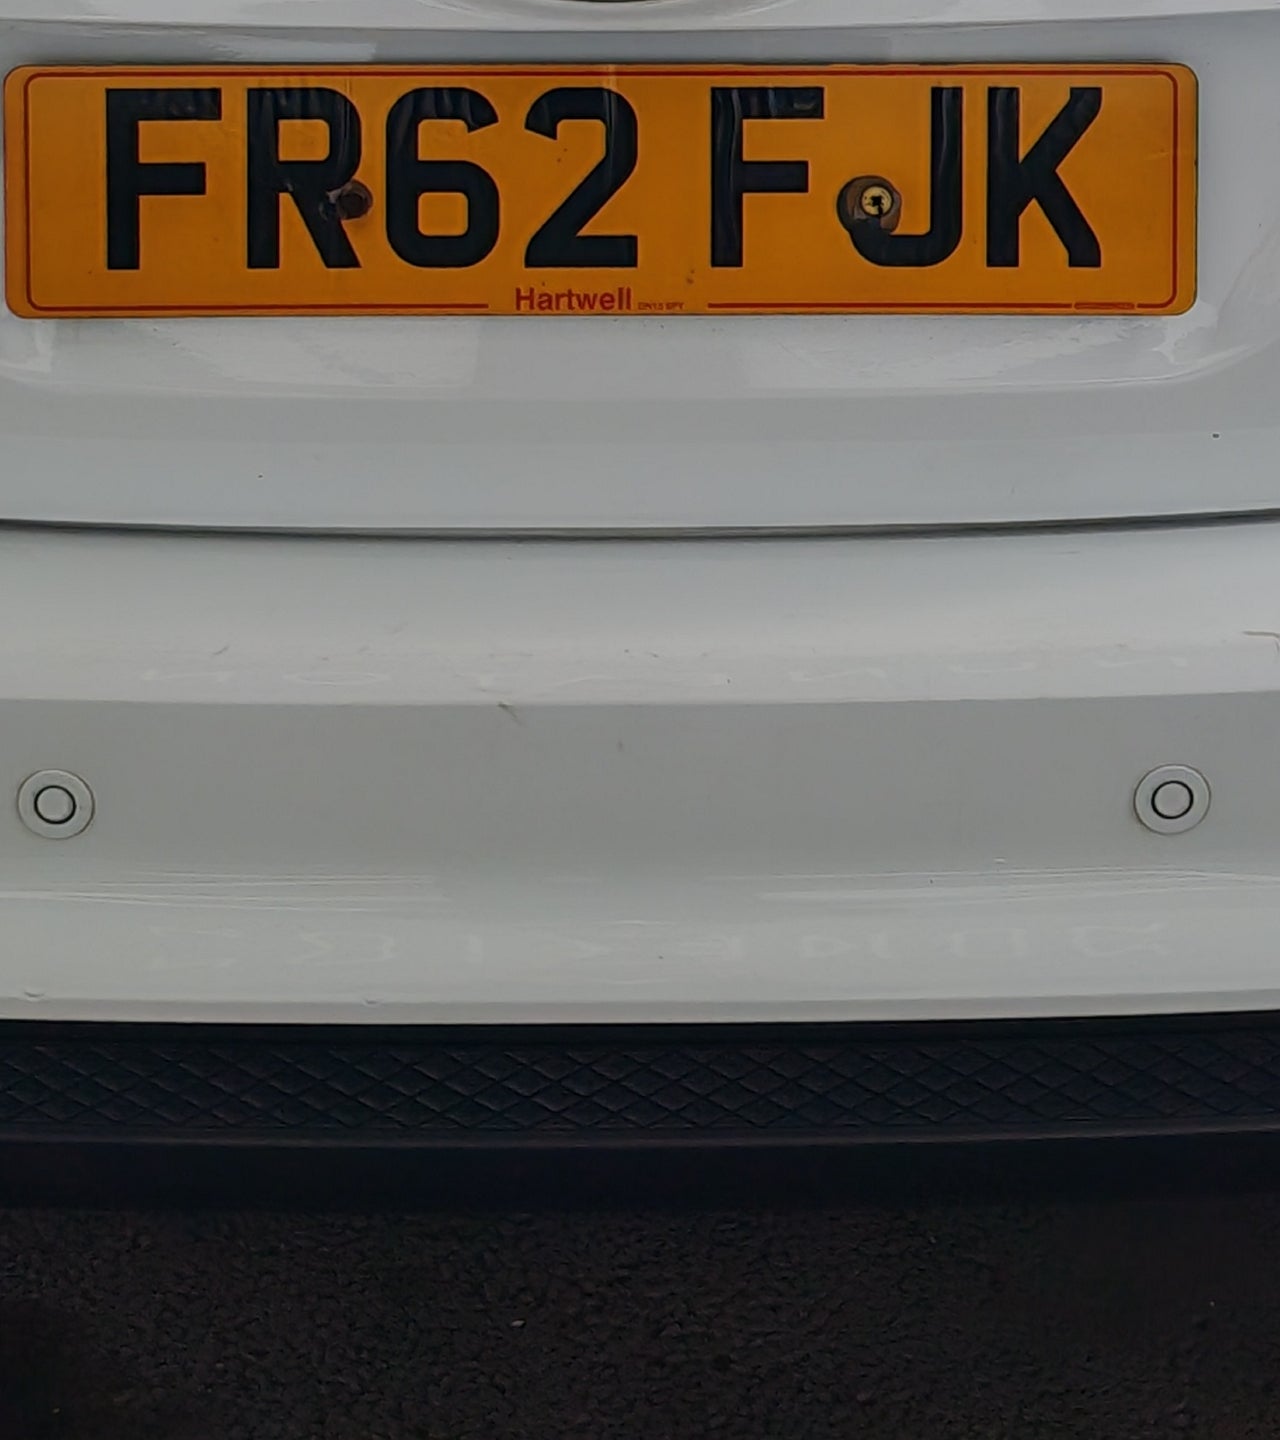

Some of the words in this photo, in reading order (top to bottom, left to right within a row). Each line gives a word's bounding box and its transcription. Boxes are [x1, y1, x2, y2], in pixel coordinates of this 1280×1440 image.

[105, 86, 637, 271] FR62
[709, 85, 1102, 269] FJK
[515, 287, 632, 311] Hartwell
